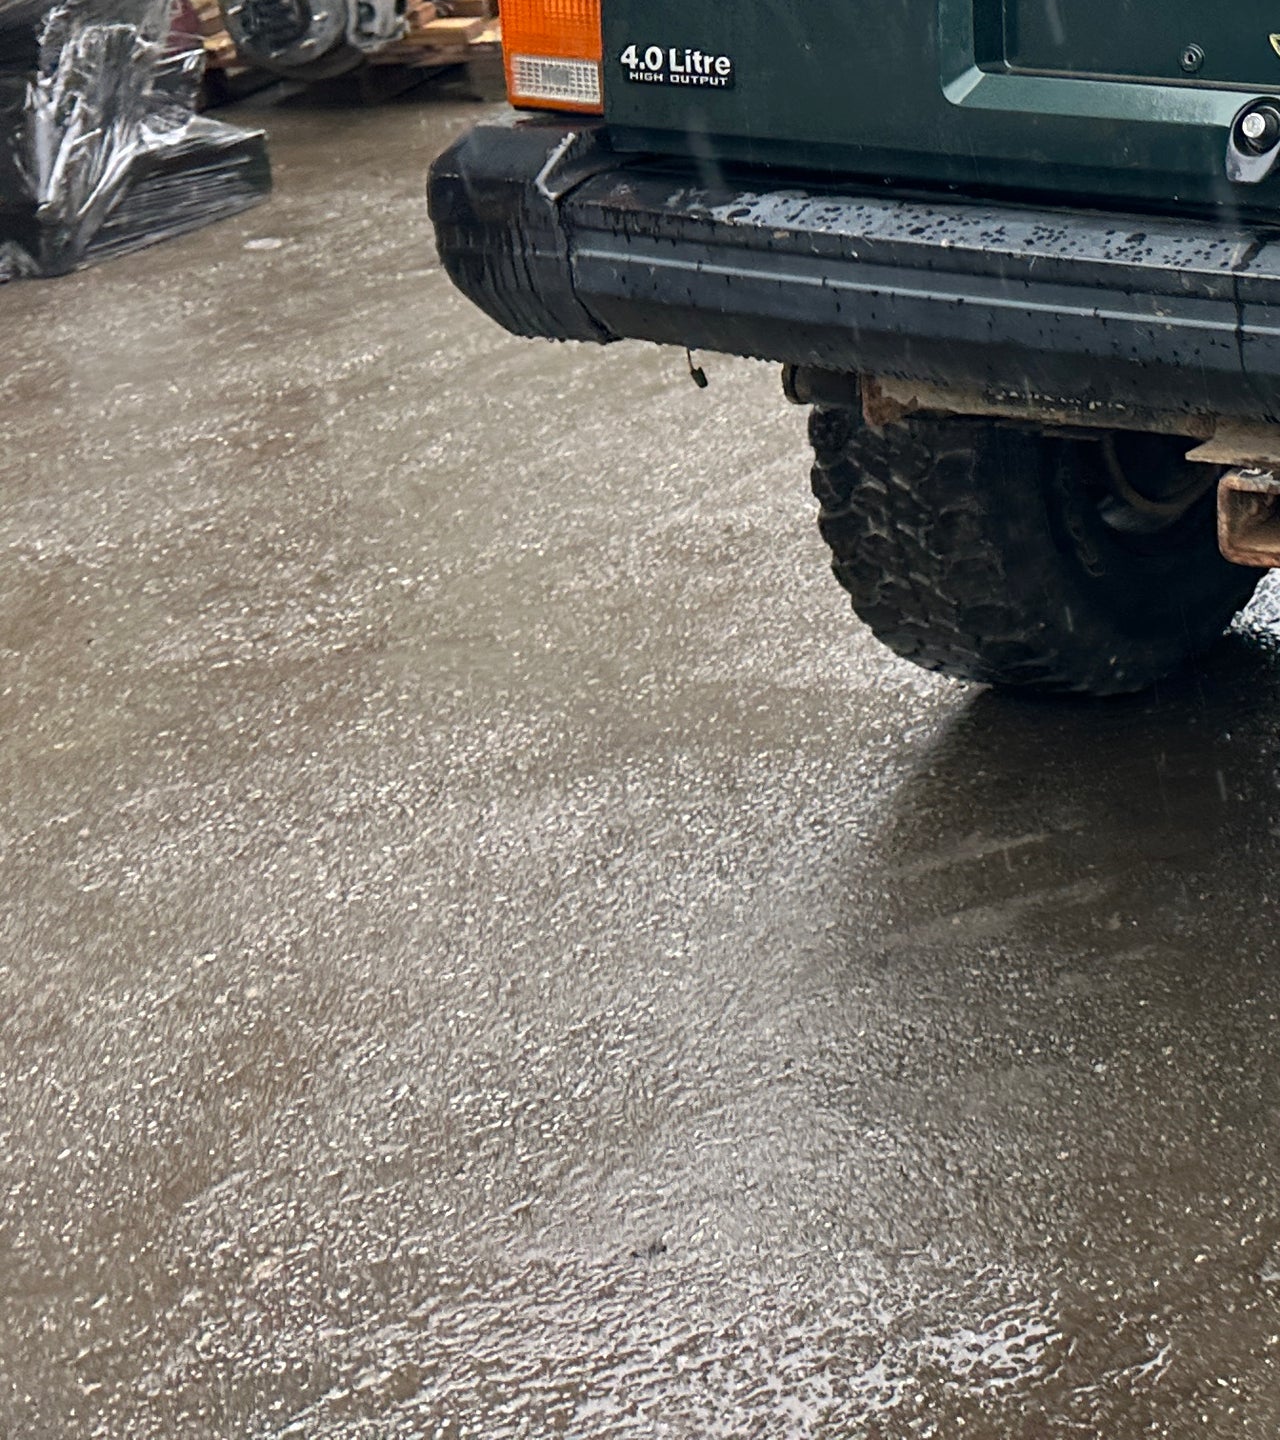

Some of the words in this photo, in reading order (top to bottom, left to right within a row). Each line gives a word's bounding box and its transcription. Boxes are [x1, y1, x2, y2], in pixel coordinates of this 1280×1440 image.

[620, 44, 663, 71] 4.0
[669, 48, 731, 75] Litre
[629, 71, 663, 82] HIGH
[669, 74, 728, 86] OUTPUT
